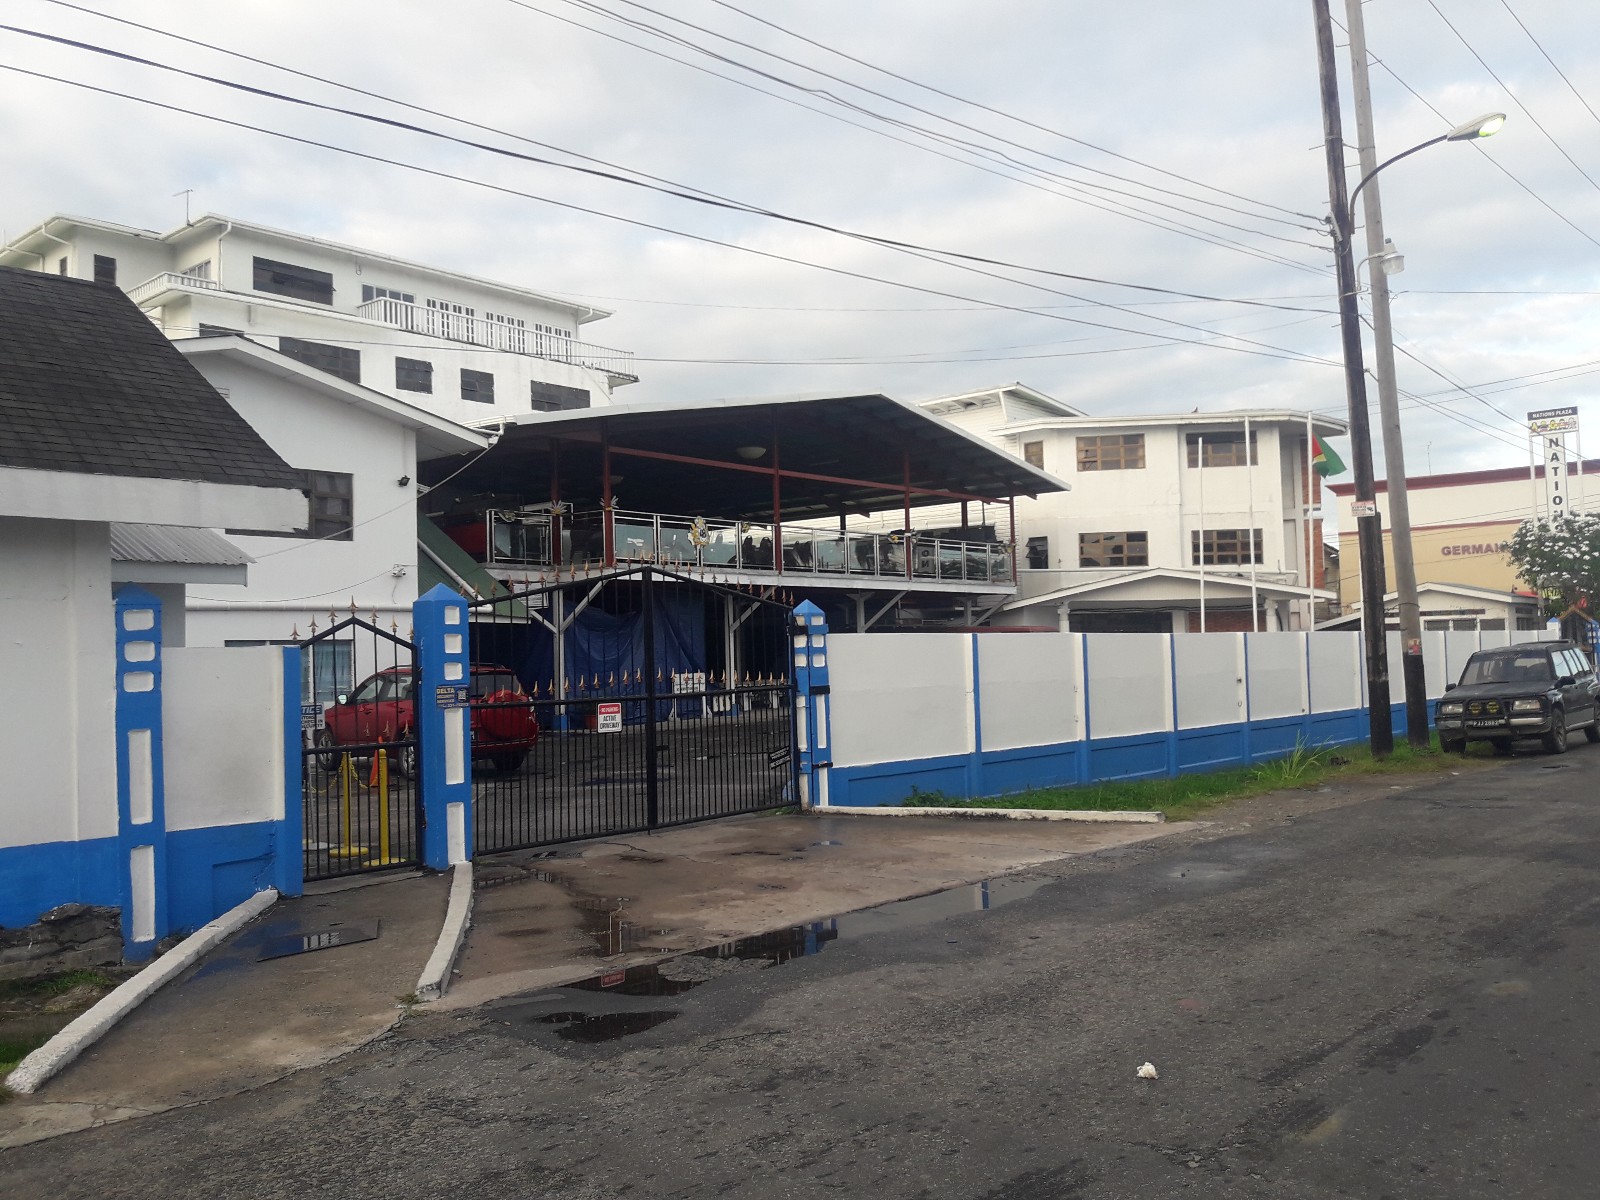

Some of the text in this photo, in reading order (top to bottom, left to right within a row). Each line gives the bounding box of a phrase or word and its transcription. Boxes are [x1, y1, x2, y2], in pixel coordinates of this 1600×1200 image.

[1532, 408, 1572, 419] NATIONS PLAZA
[301, 705, 321, 714] TICE
[600, 722, 620, 730] DRIVEWAY
